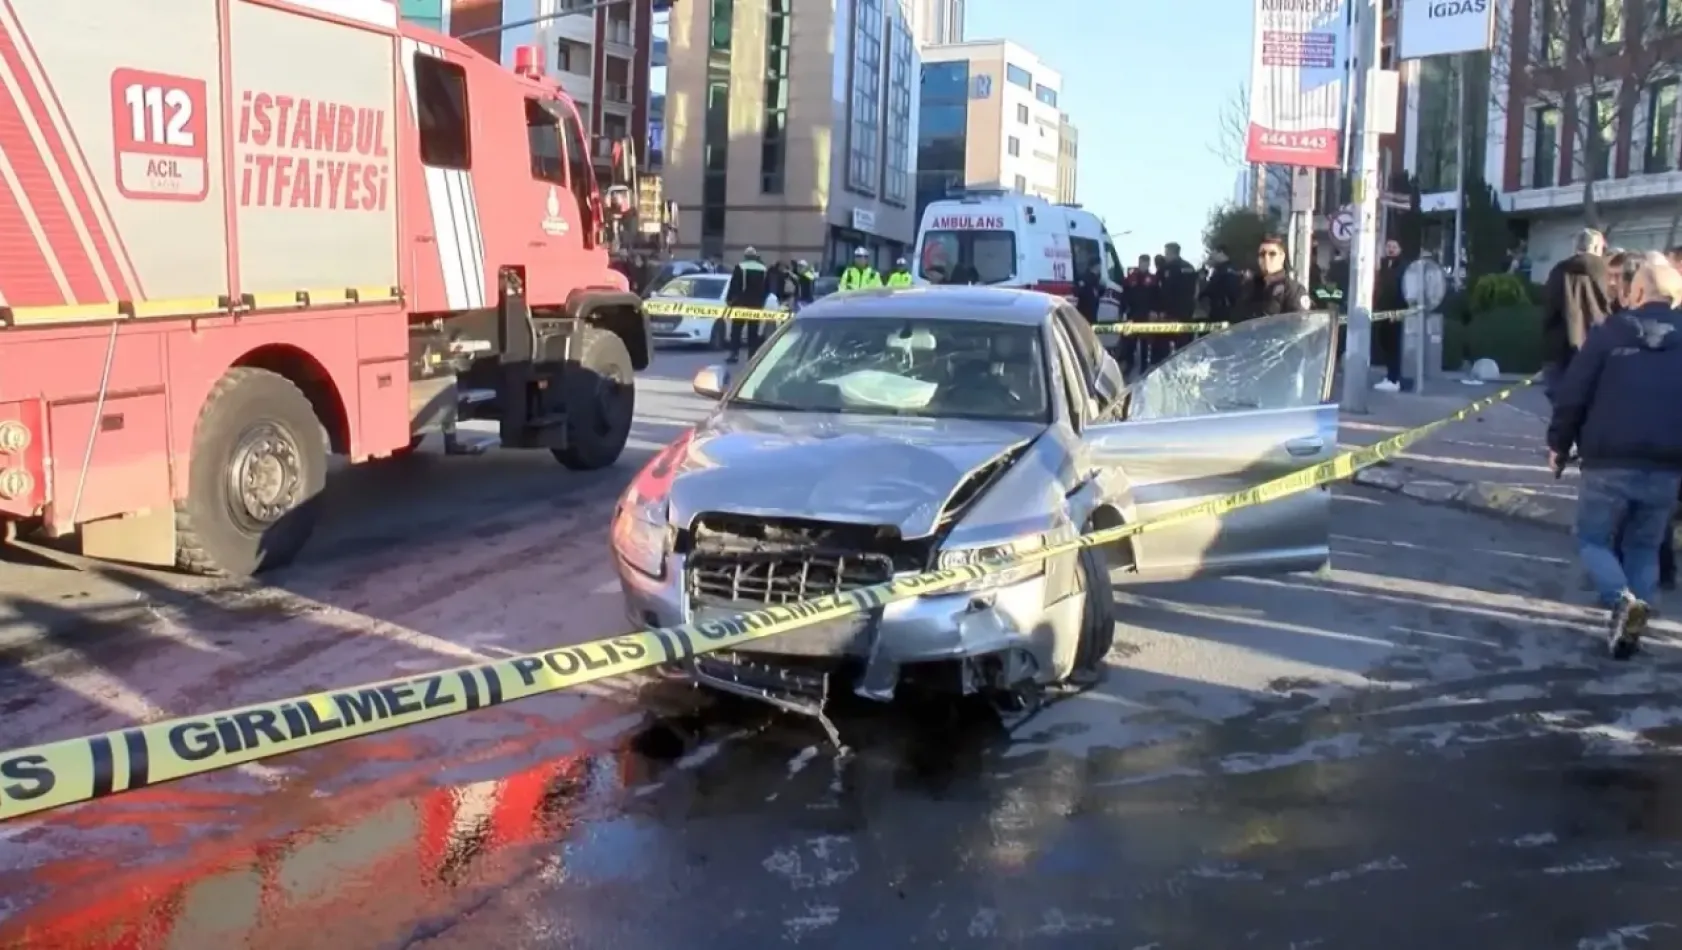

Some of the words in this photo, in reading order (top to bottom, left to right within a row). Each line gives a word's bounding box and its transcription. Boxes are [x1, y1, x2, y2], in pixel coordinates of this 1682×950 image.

[125, 84, 194, 147] 112
[239, 91, 388, 157] İSTANBUL
[241, 154, 388, 211] İTFAİYESİ
[932, 216, 1004, 229] AMBULANS
[1053, 261, 1067, 281] 112
[168, 675, 456, 761] GİRİLMEZ
